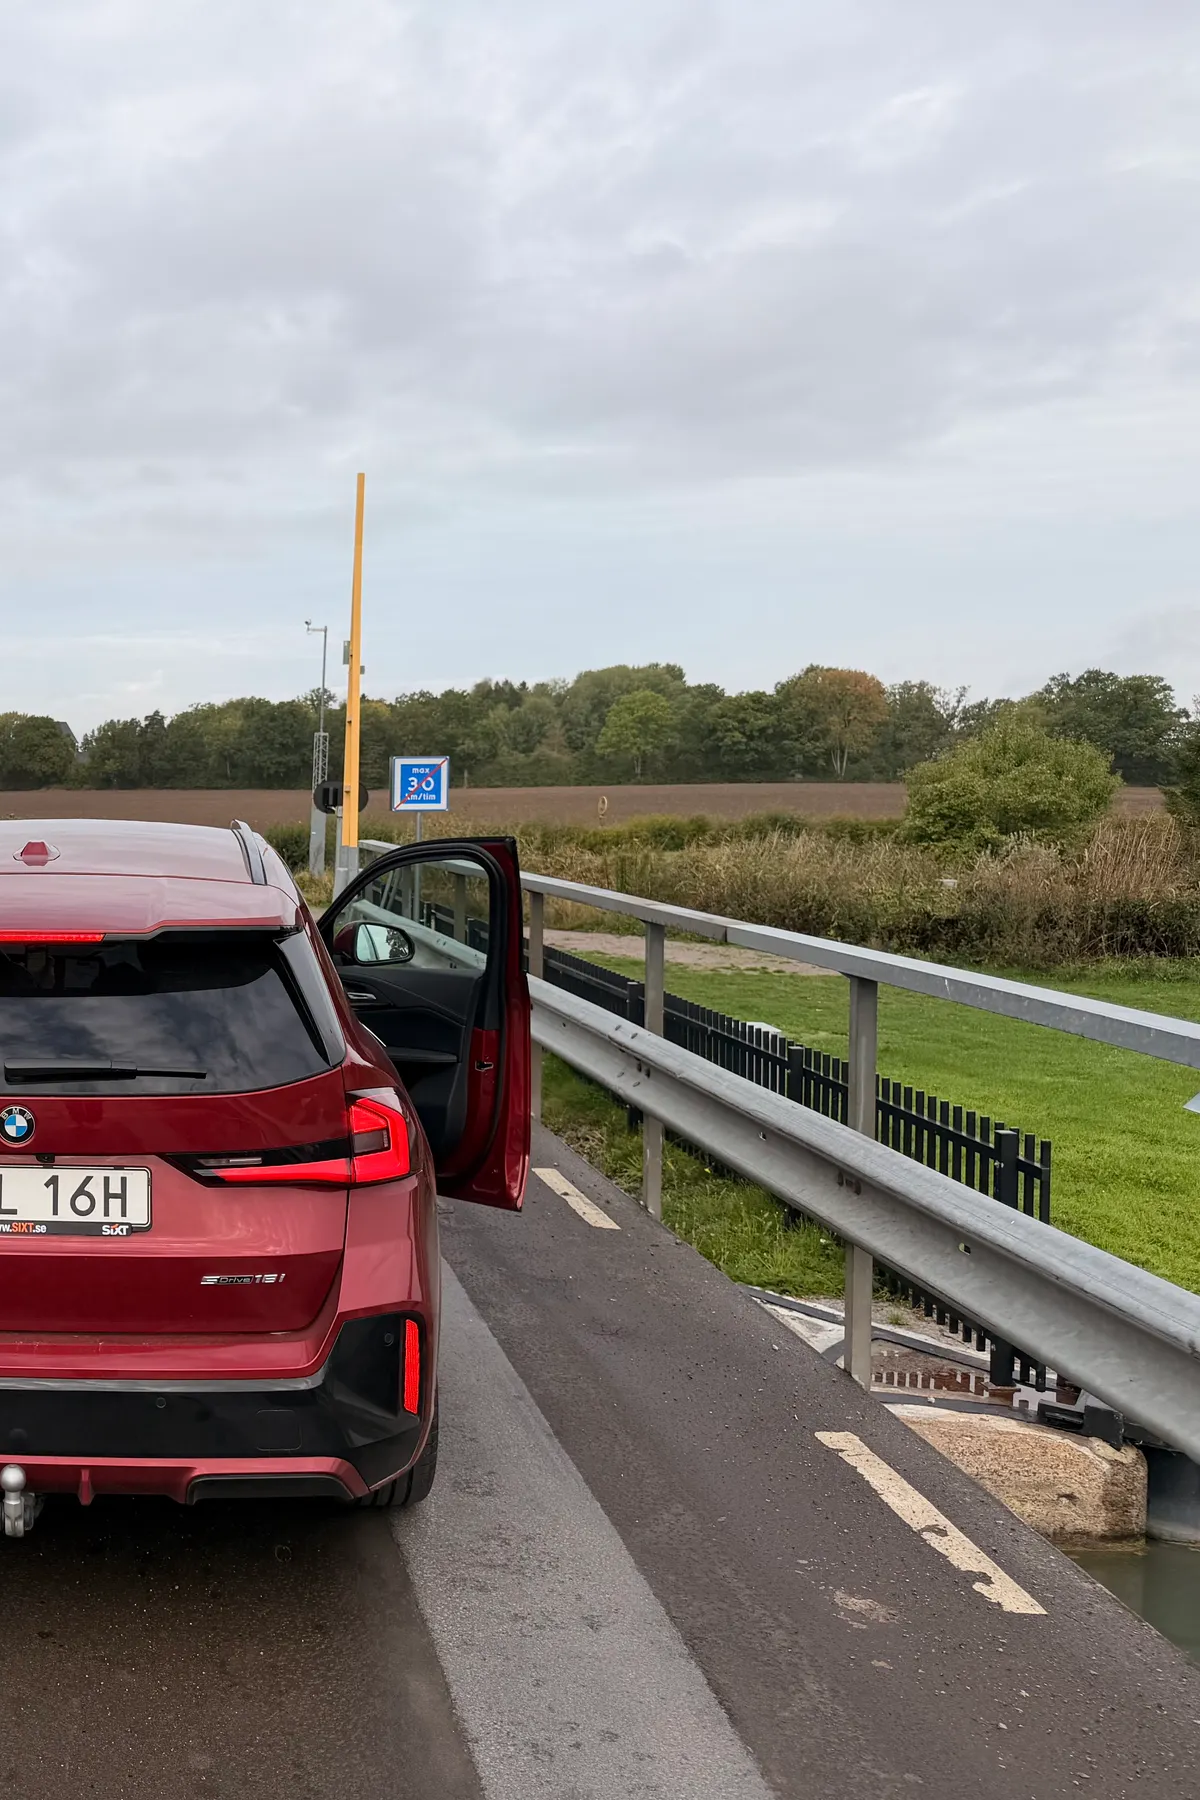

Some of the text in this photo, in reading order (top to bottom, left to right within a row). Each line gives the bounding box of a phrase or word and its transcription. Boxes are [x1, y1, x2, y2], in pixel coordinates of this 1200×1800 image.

[408, 777, 435, 791] 30
[0, 1108, 32, 1120] BMW
[43, 1174, 128, 1218] 16H
